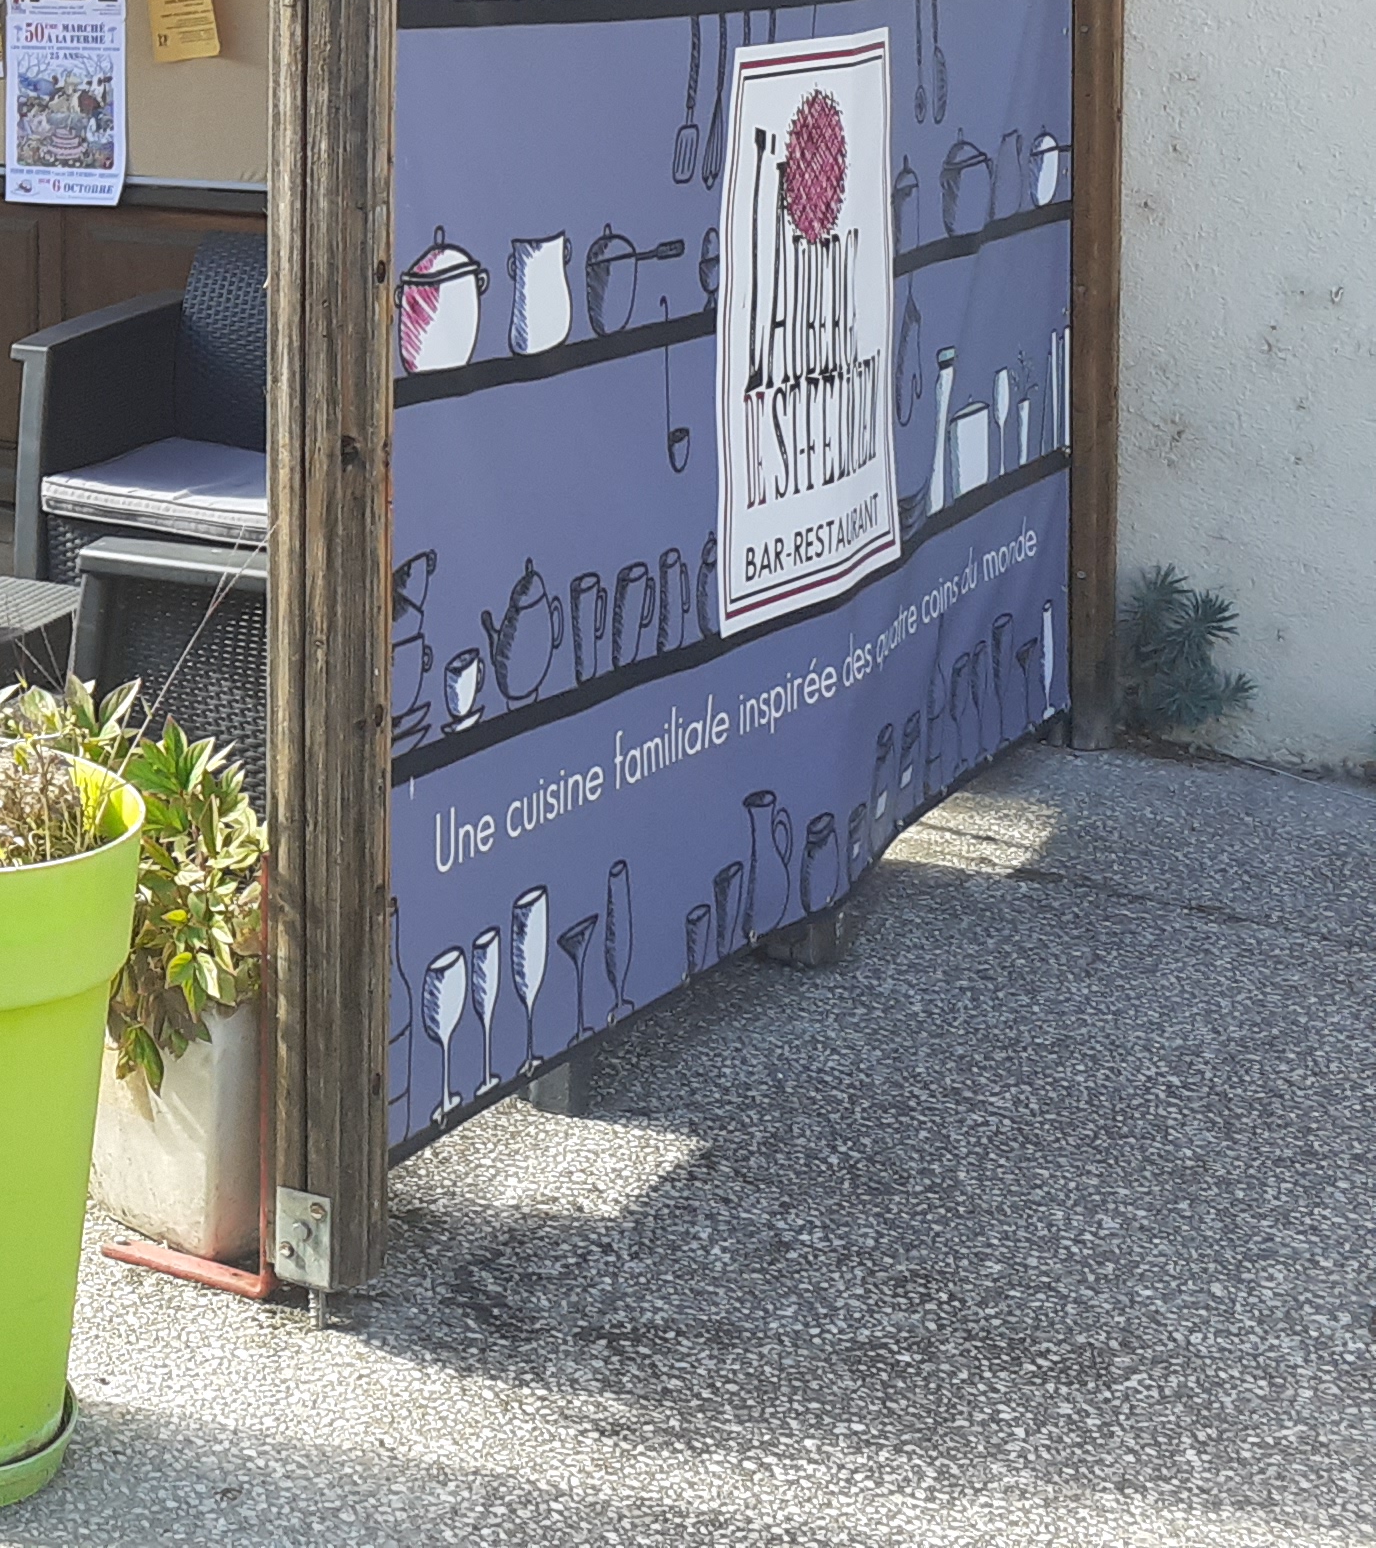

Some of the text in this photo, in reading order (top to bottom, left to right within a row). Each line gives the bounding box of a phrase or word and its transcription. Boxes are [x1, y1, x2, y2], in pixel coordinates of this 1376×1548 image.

[61, 21, 106, 33] MARCHÉ
[70, 34, 106, 45] FERME
[743, 390, 767, 510] DE
[745, 492, 880, 584] BAR-RESTAURANT
[435, 516, 1038, 873] Une cuisine familiale inspirée des quatre coins du monde
